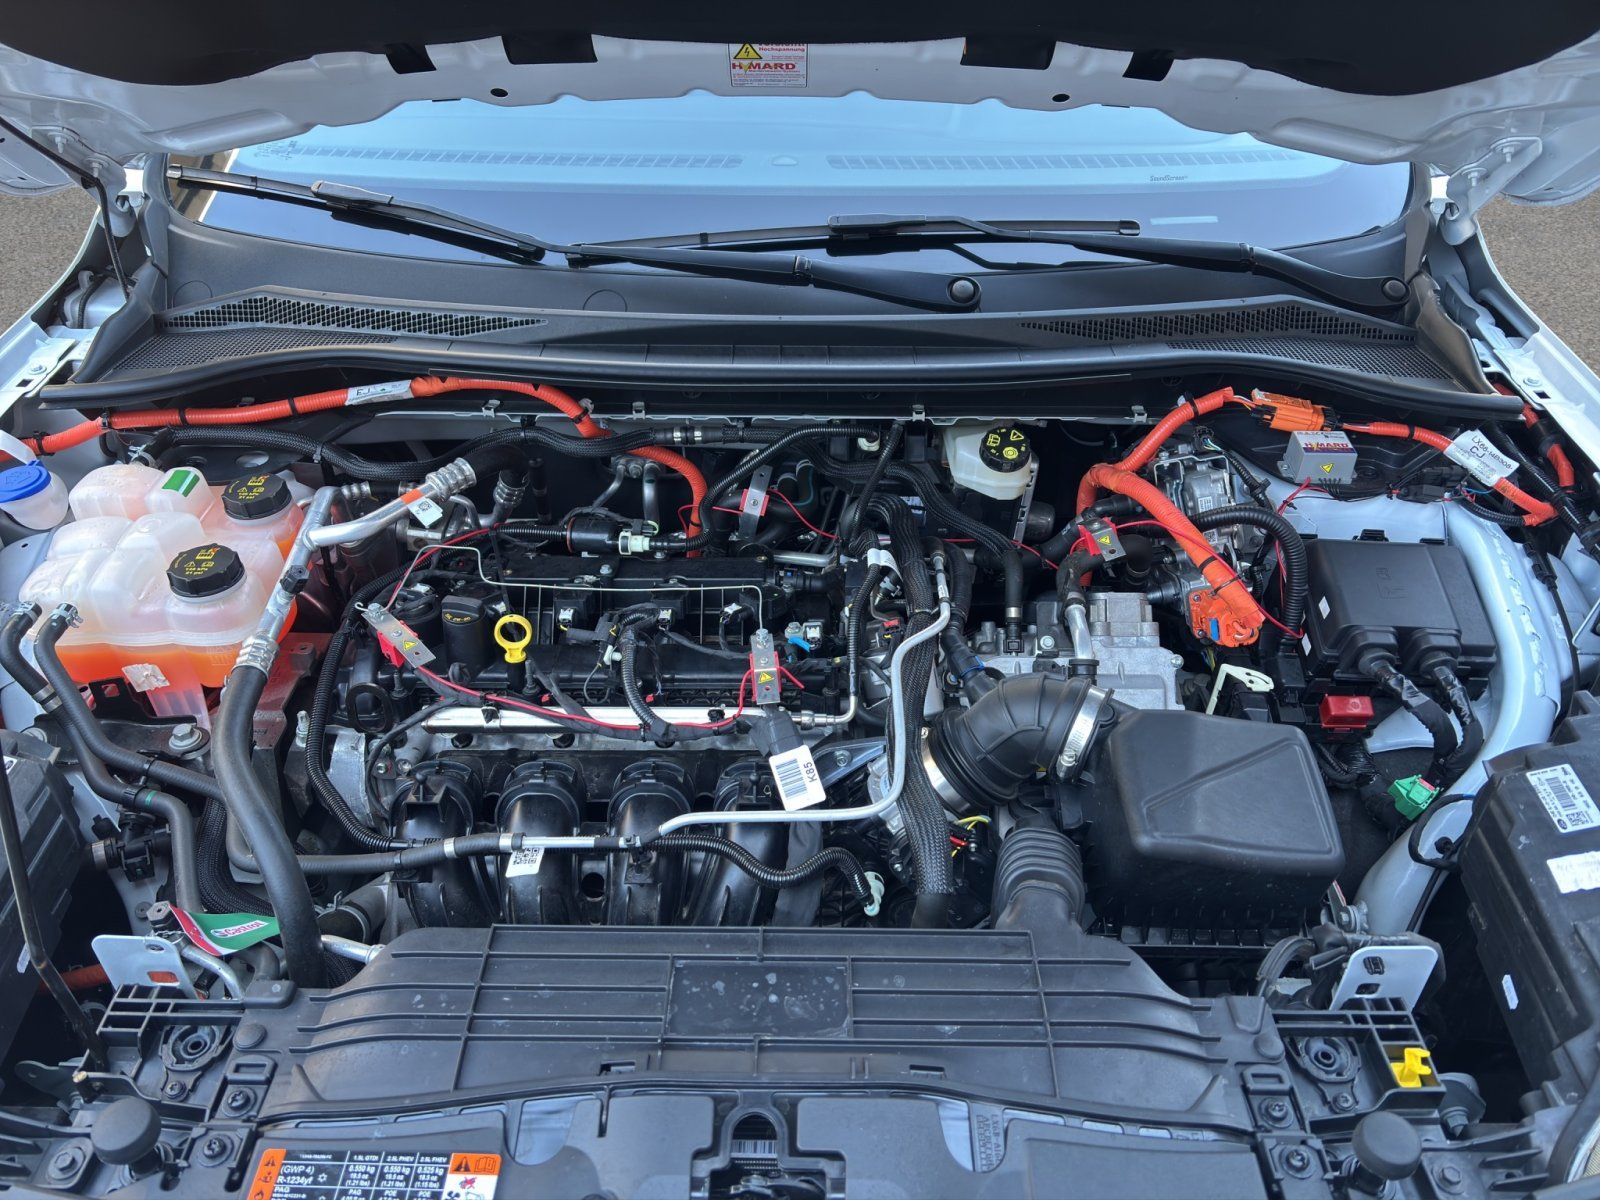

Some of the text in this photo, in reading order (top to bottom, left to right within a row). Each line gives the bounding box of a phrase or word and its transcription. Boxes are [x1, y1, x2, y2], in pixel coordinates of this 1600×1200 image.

[1469, 445, 1486, 459] CJ
[803, 761, 818, 783] K85
[224, 921, 264, 936] Castrol
[280, 1164, 315, 1175] (GWP 4)
[366, 1165, 376, 1174] kg
[383, 1165, 411, 1175] 0.550 kg
[416, 1166, 444, 1176] 0.525 kg
[276, 1175, 314, 1186] R-1234yf
[345, 1179, 359, 1187] (1.21
[380, 1180, 394, 1188] (1.21
[384, 1189, 398, 1197] POE
